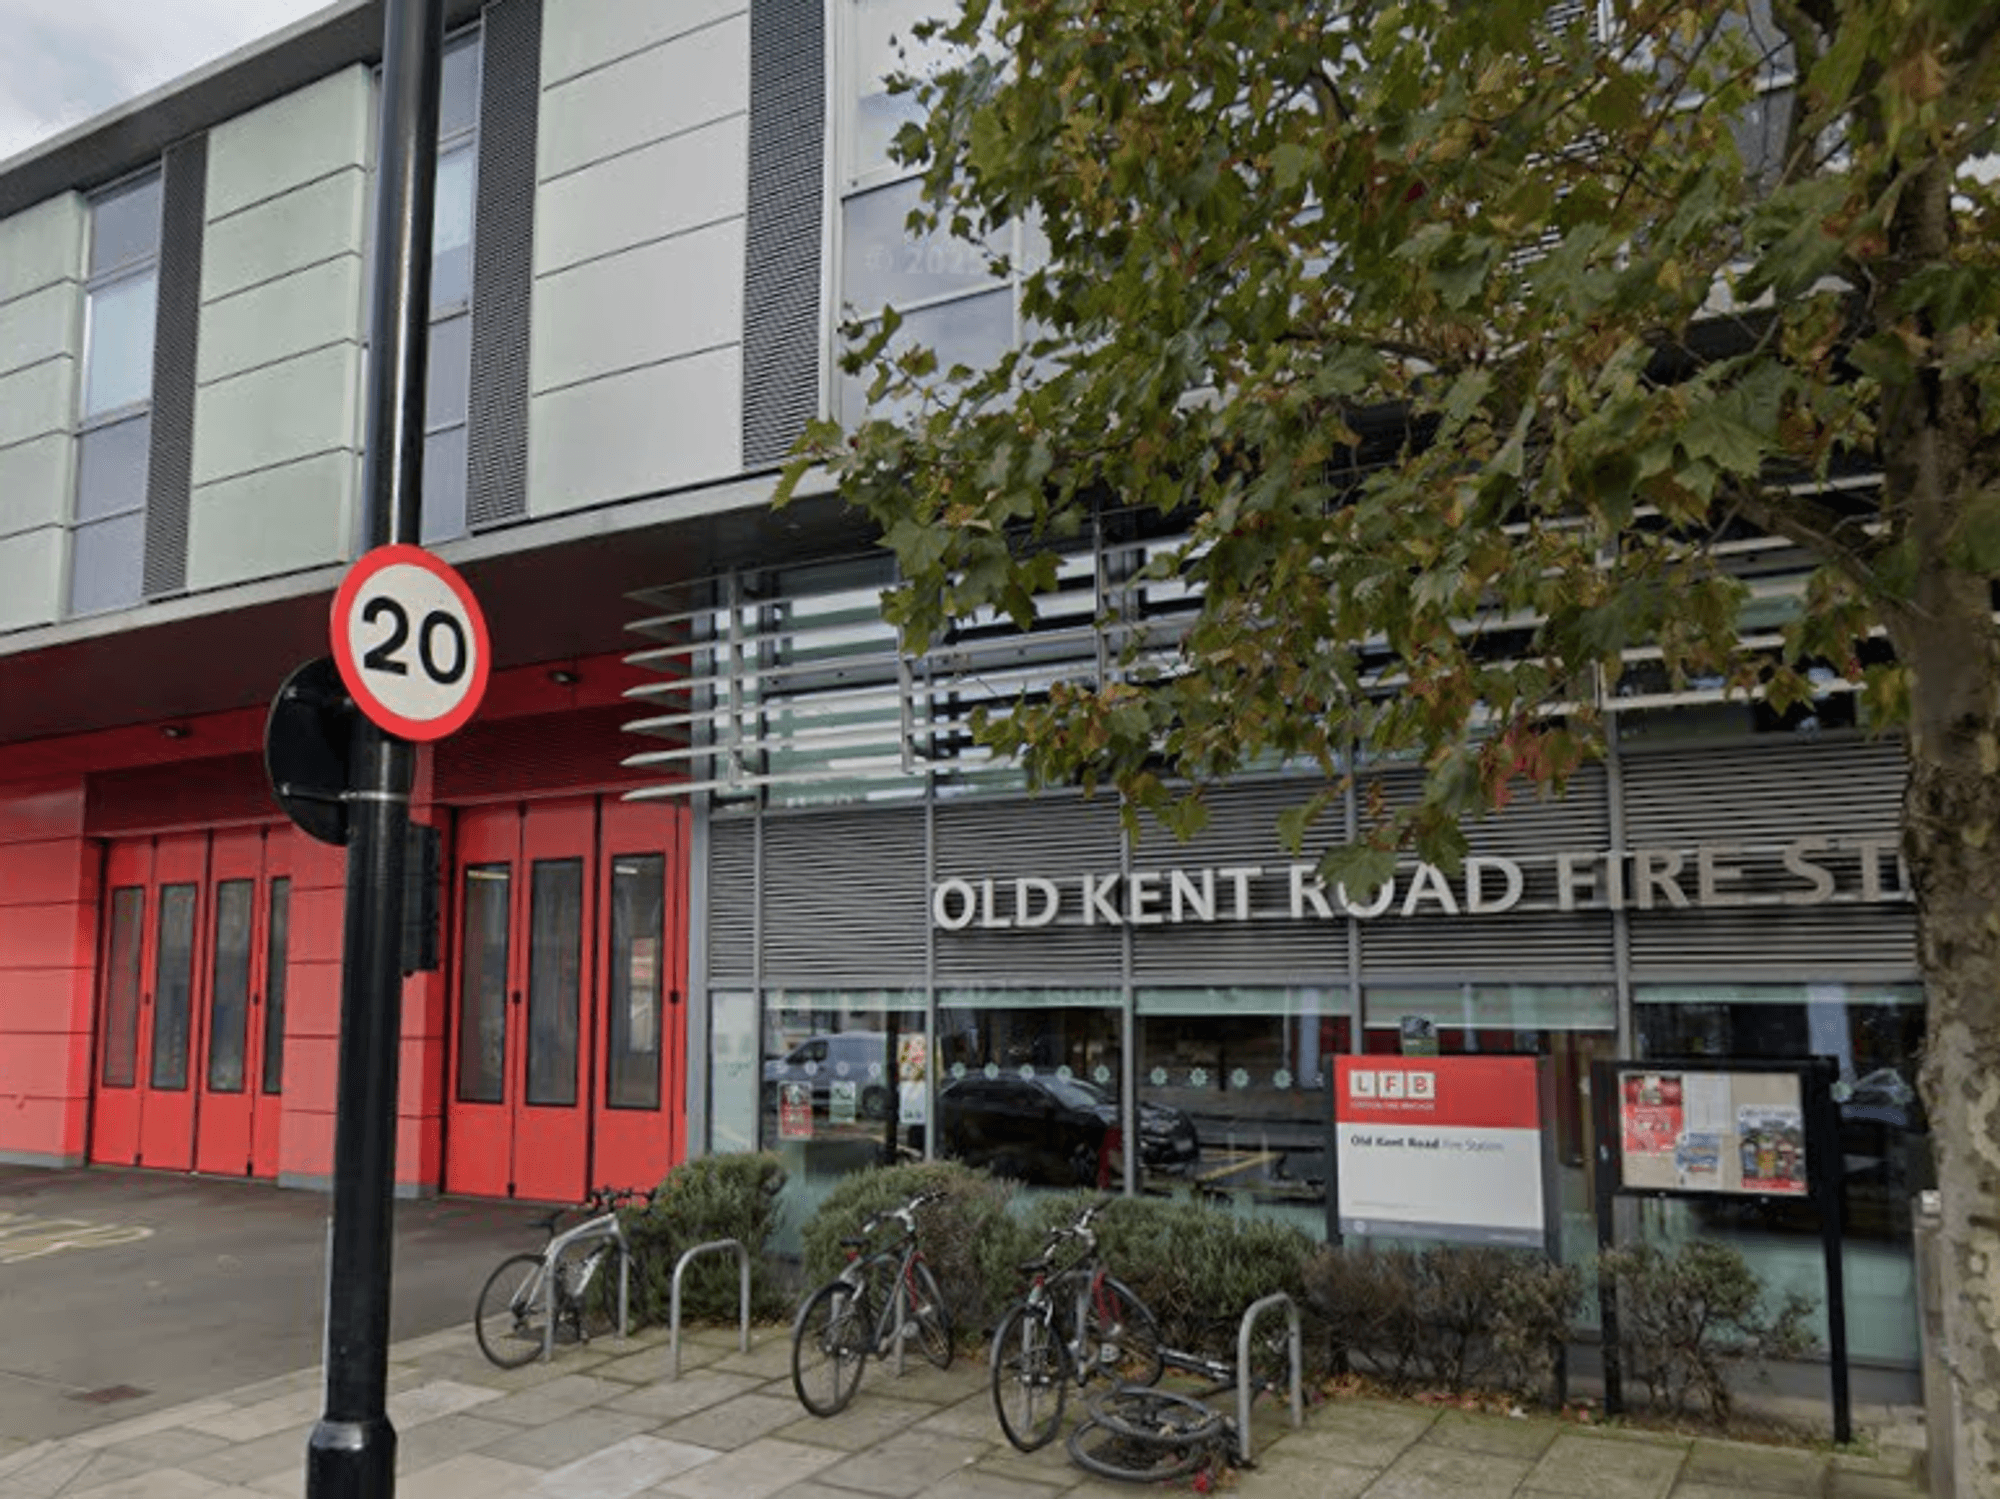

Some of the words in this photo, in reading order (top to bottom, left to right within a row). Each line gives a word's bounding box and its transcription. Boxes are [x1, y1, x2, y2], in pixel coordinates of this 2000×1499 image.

[362, 595, 468, 686] 20
[932, 877, 1059, 930] OLD
[1082, 866, 1262, 924] KENT
[1555, 844, 1747, 911] FIRE
[1782, 837, 1917, 904] ST
[1350, 1134, 1373, 1147] Old
[1375, 1136, 1405, 1147] Kent
[1407, 1137, 1440, 1149] Road
